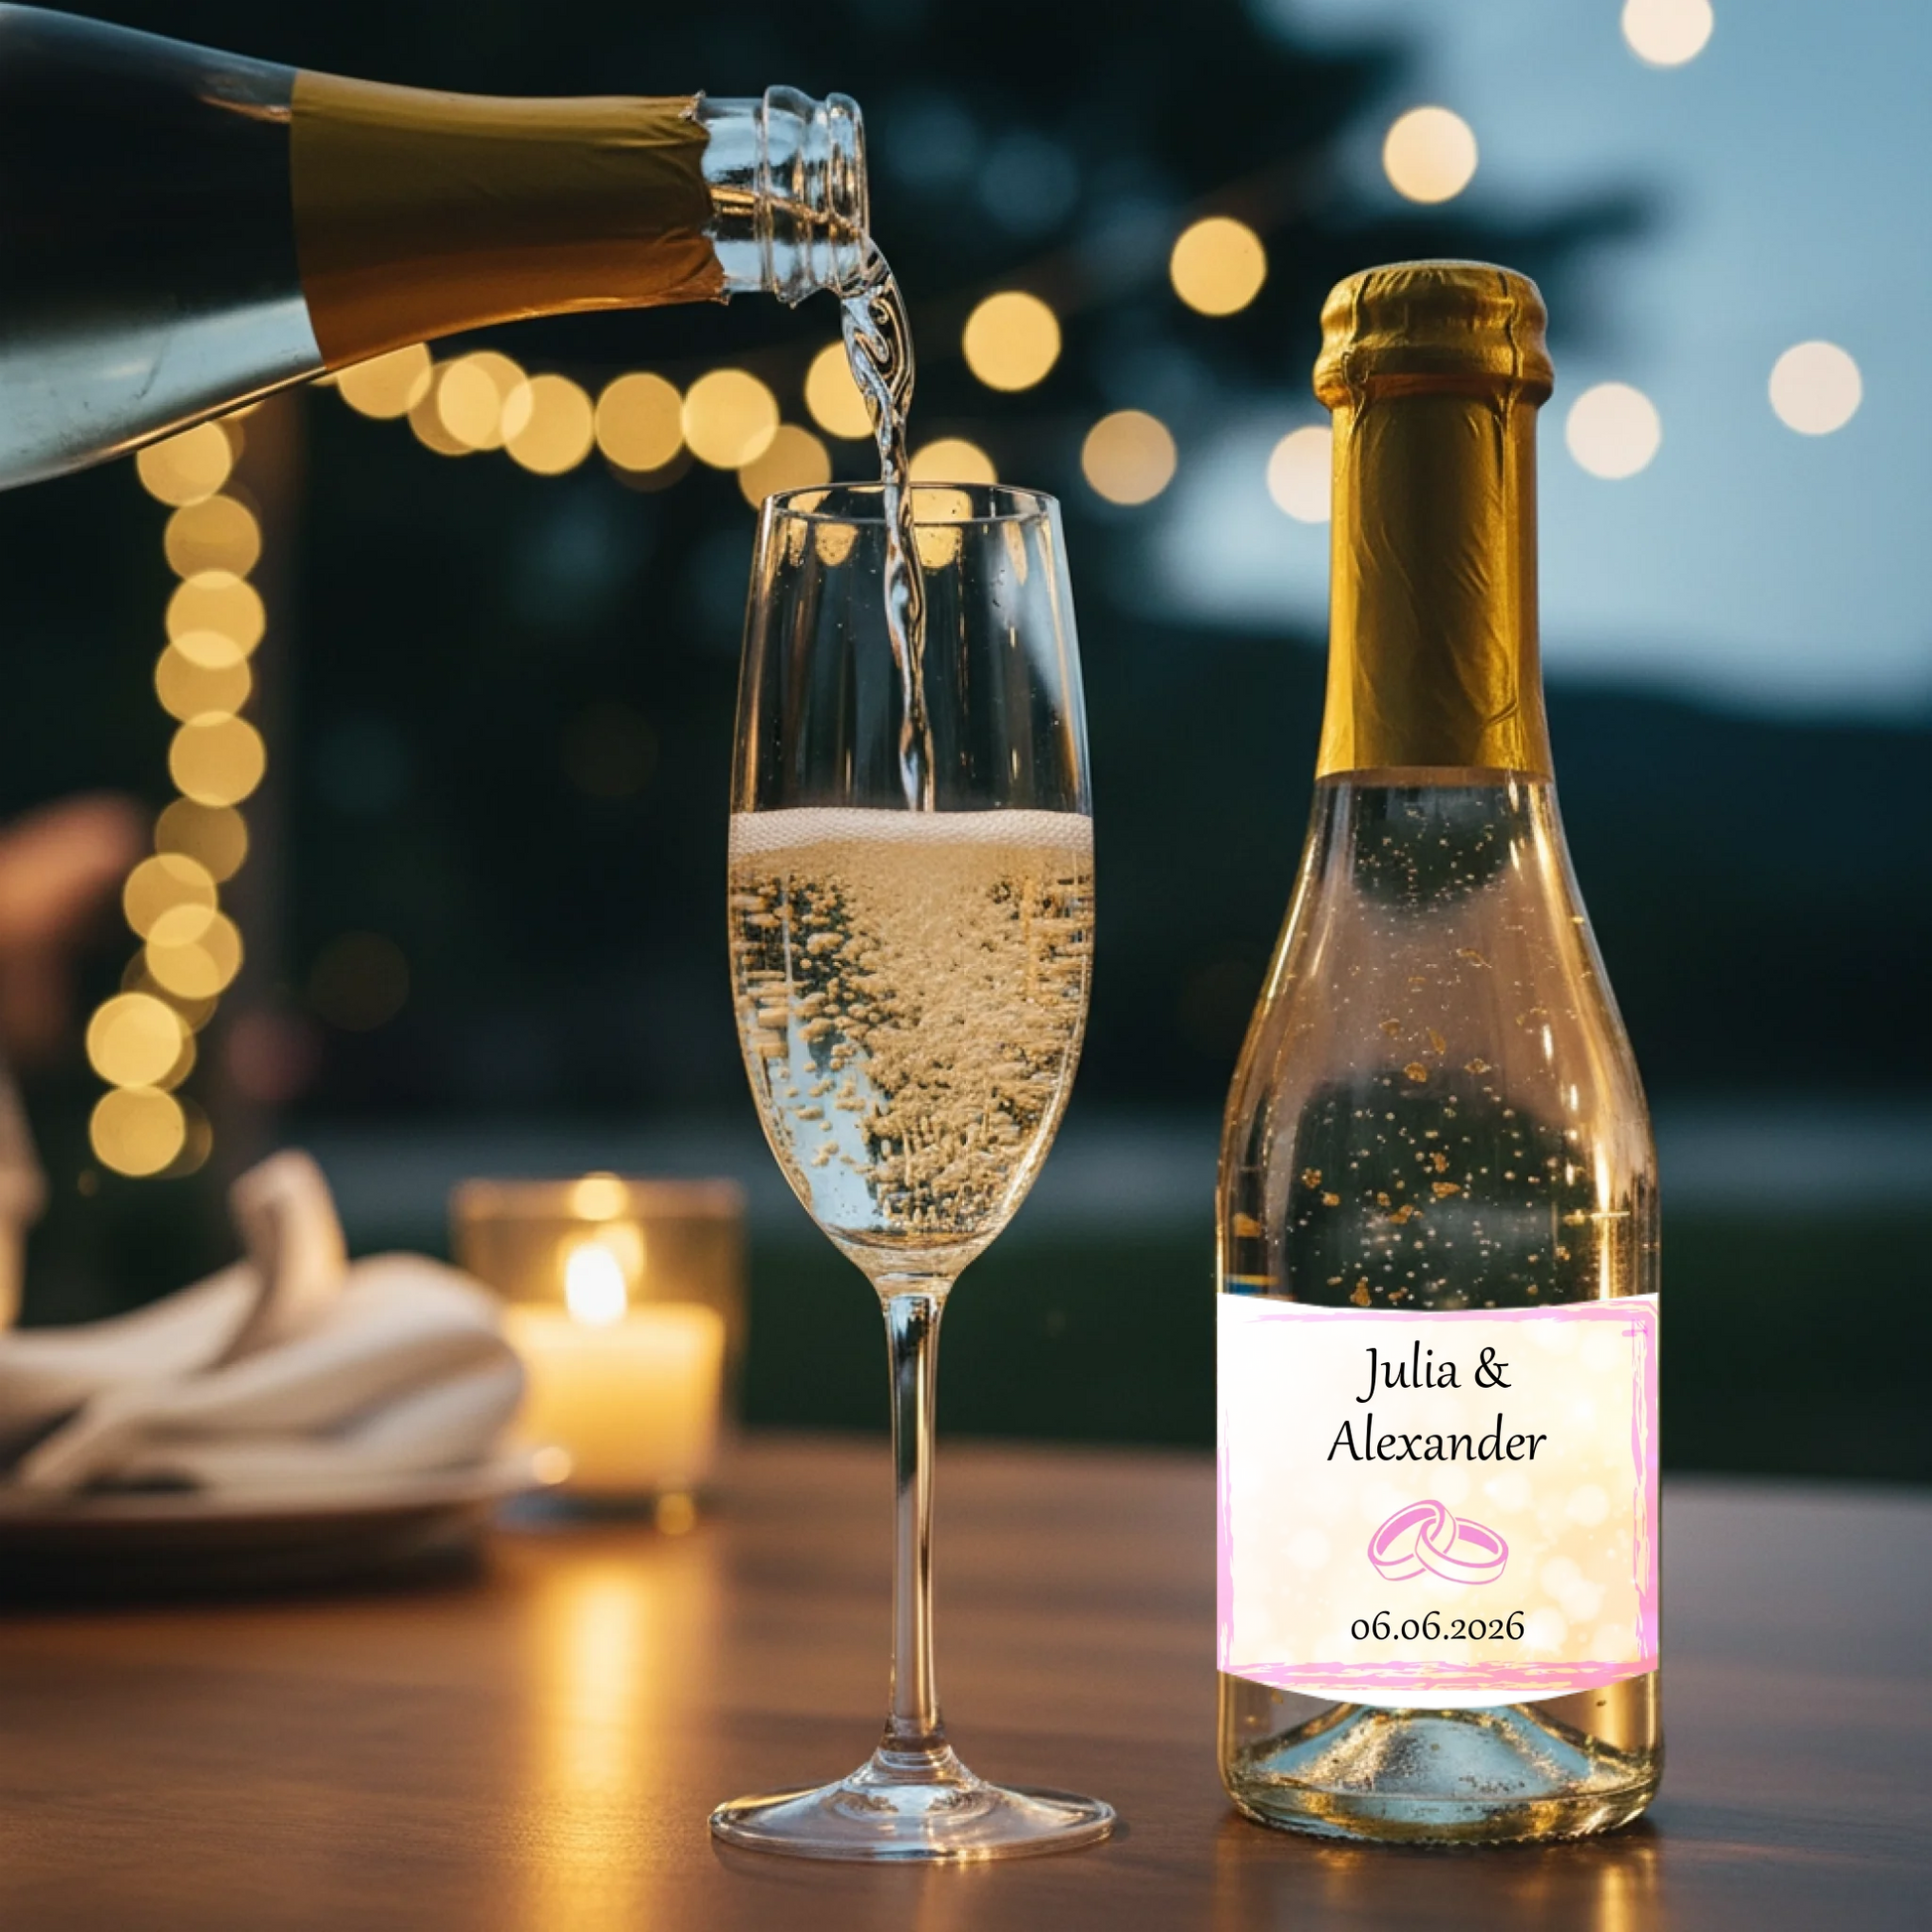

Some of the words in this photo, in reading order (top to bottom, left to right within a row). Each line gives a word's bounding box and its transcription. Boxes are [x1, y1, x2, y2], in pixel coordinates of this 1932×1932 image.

[1355, 1339, 1462, 1404] Julia
[1474, 1346, 1513, 1389] &
[1326, 1412, 1548, 1462] Alexander
[1350, 1610, 1526, 1641] 06.06.2026
